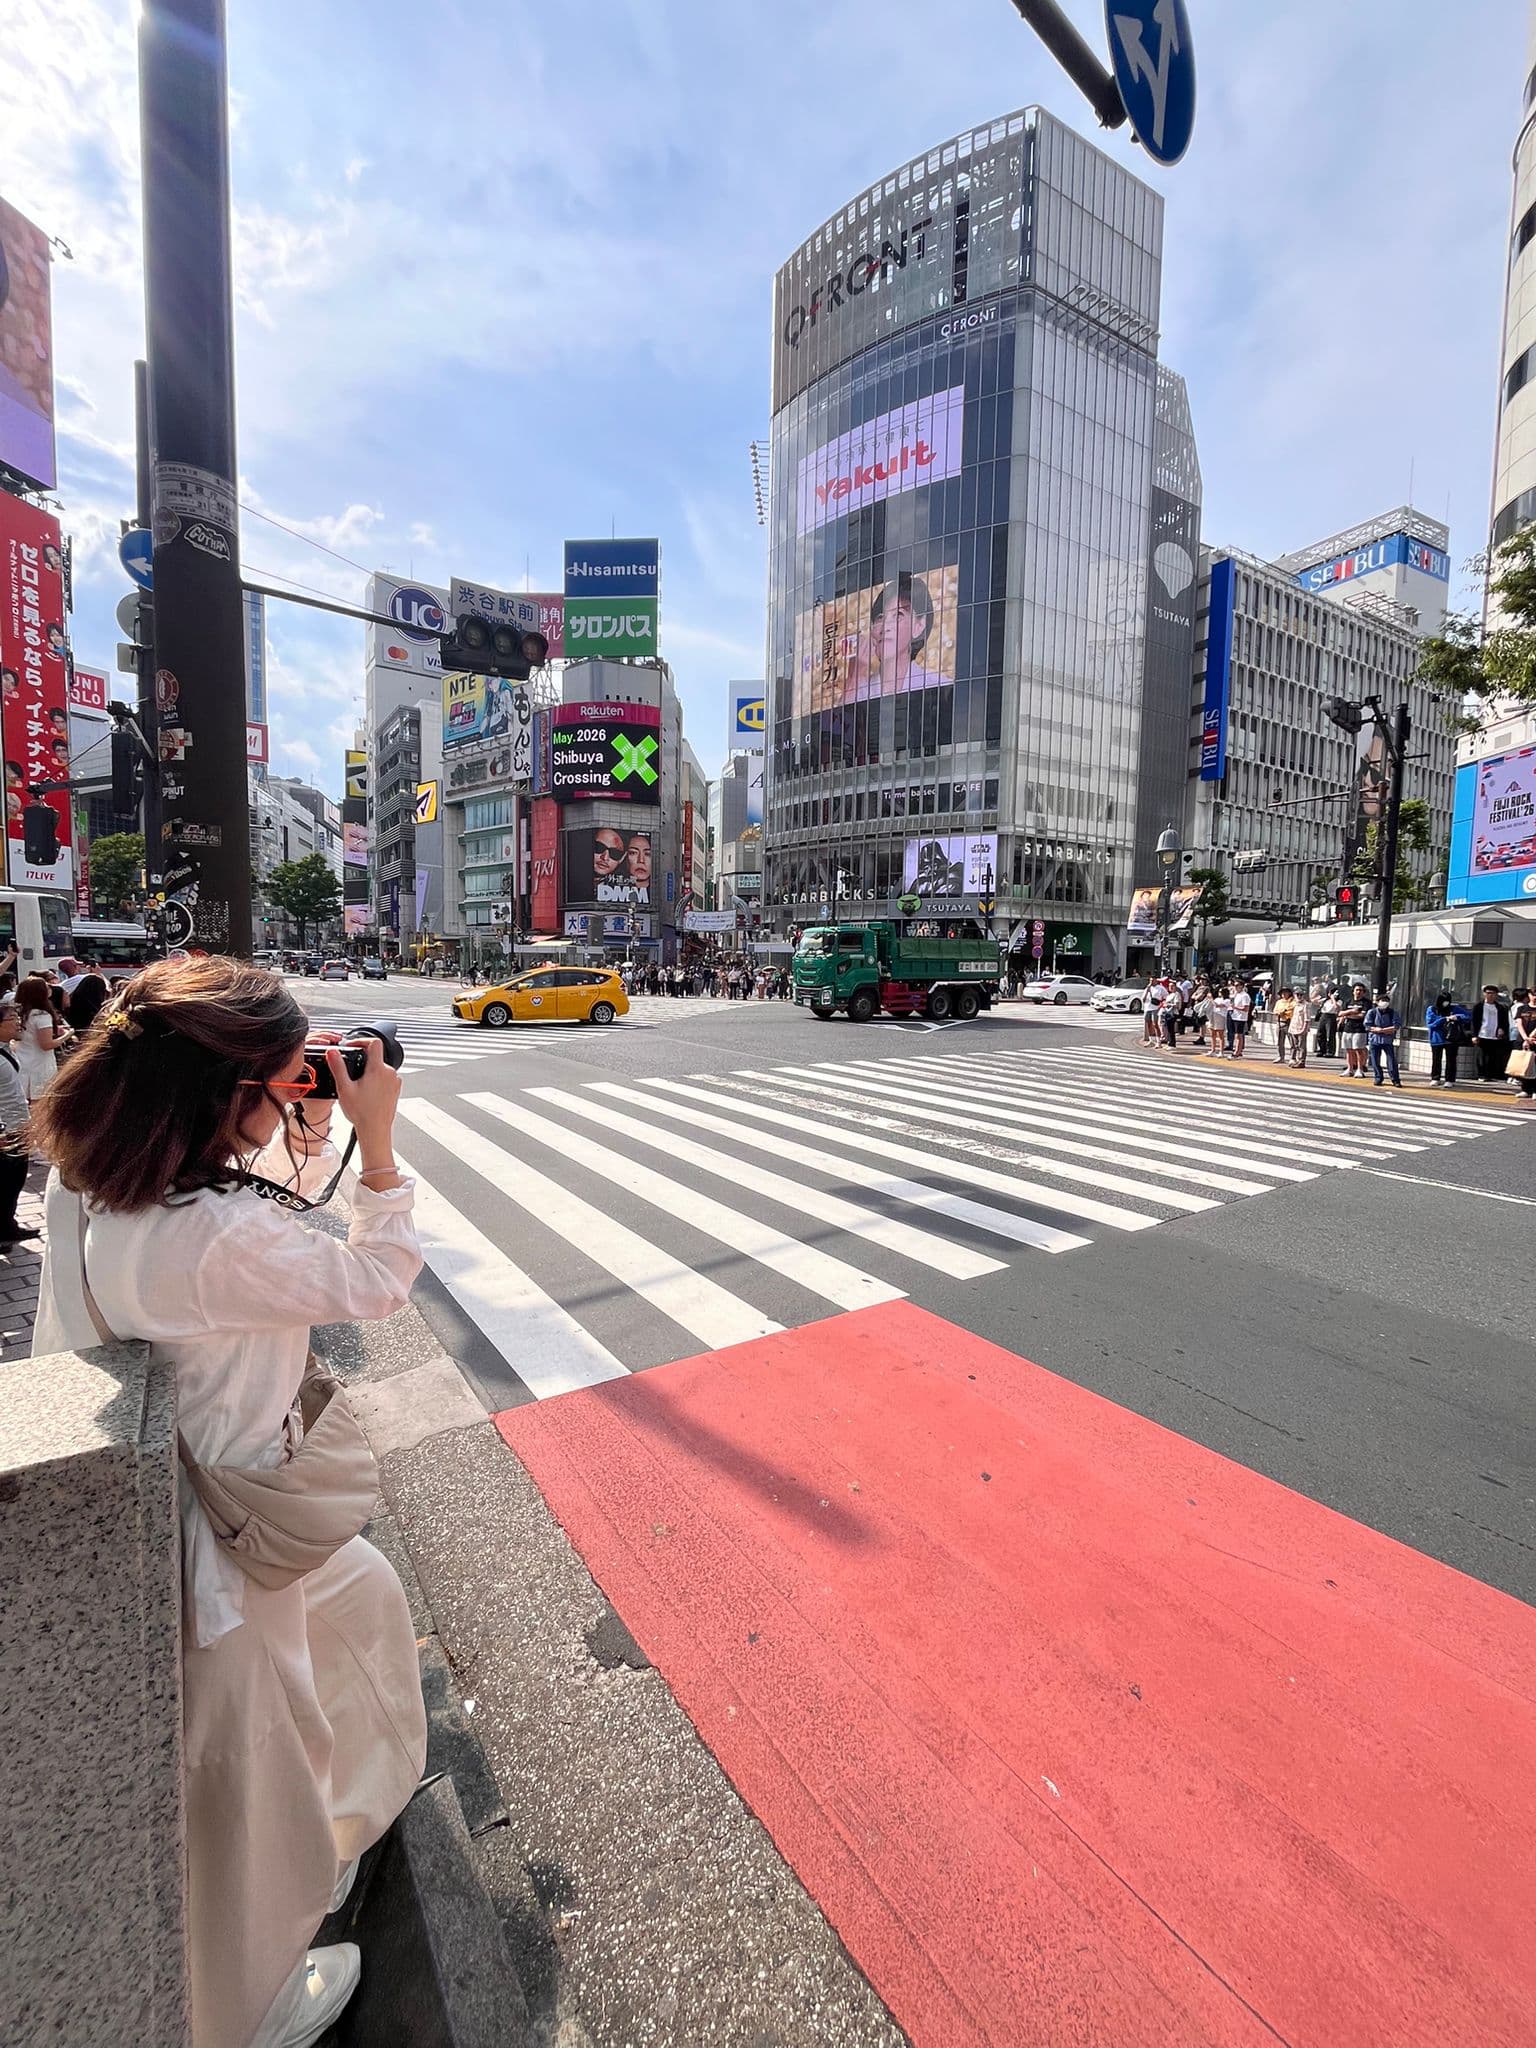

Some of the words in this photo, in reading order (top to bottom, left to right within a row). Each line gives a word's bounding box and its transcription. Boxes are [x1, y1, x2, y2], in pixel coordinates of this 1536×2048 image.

[784, 217, 932, 350] QFRONT
[941, 307, 998, 338] QFRONT
[815, 439, 937, 506] Yakult
[566, 562, 656, 576] Hisamitsu
[1309, 543, 1385, 592] SEIBU
[1408, 542, 1448, 578] SEIBU
[458, 586, 534, 622] 渋谷駅前
[570, 615, 652, 638] サロンパス
[1153, 605, 1191, 628] TSUTAYA
[580, 705, 624, 716] Rakuten
[1202, 709, 1220, 768] SEIBU
[553, 750, 604, 766] Shibuya
[553, 770, 611, 786] Crossing
[954, 783, 981, 794] CAFE
[1493, 797, 1510, 811] FUJI
[1511, 792, 1532, 807] ROCK
[1024, 842, 1111, 865] STARBUCKS
[26, 870, 56, 881] 17LIVE
[597, 883, 650, 903] DMM
[783, 888, 875, 904] STARBUCKS
[926, 904, 972, 912] TSUTAYA
[906, 921, 940, 930] STAR
[907, 928, 939, 937] WARS
[248, 1181, 305, 1210] SONY
